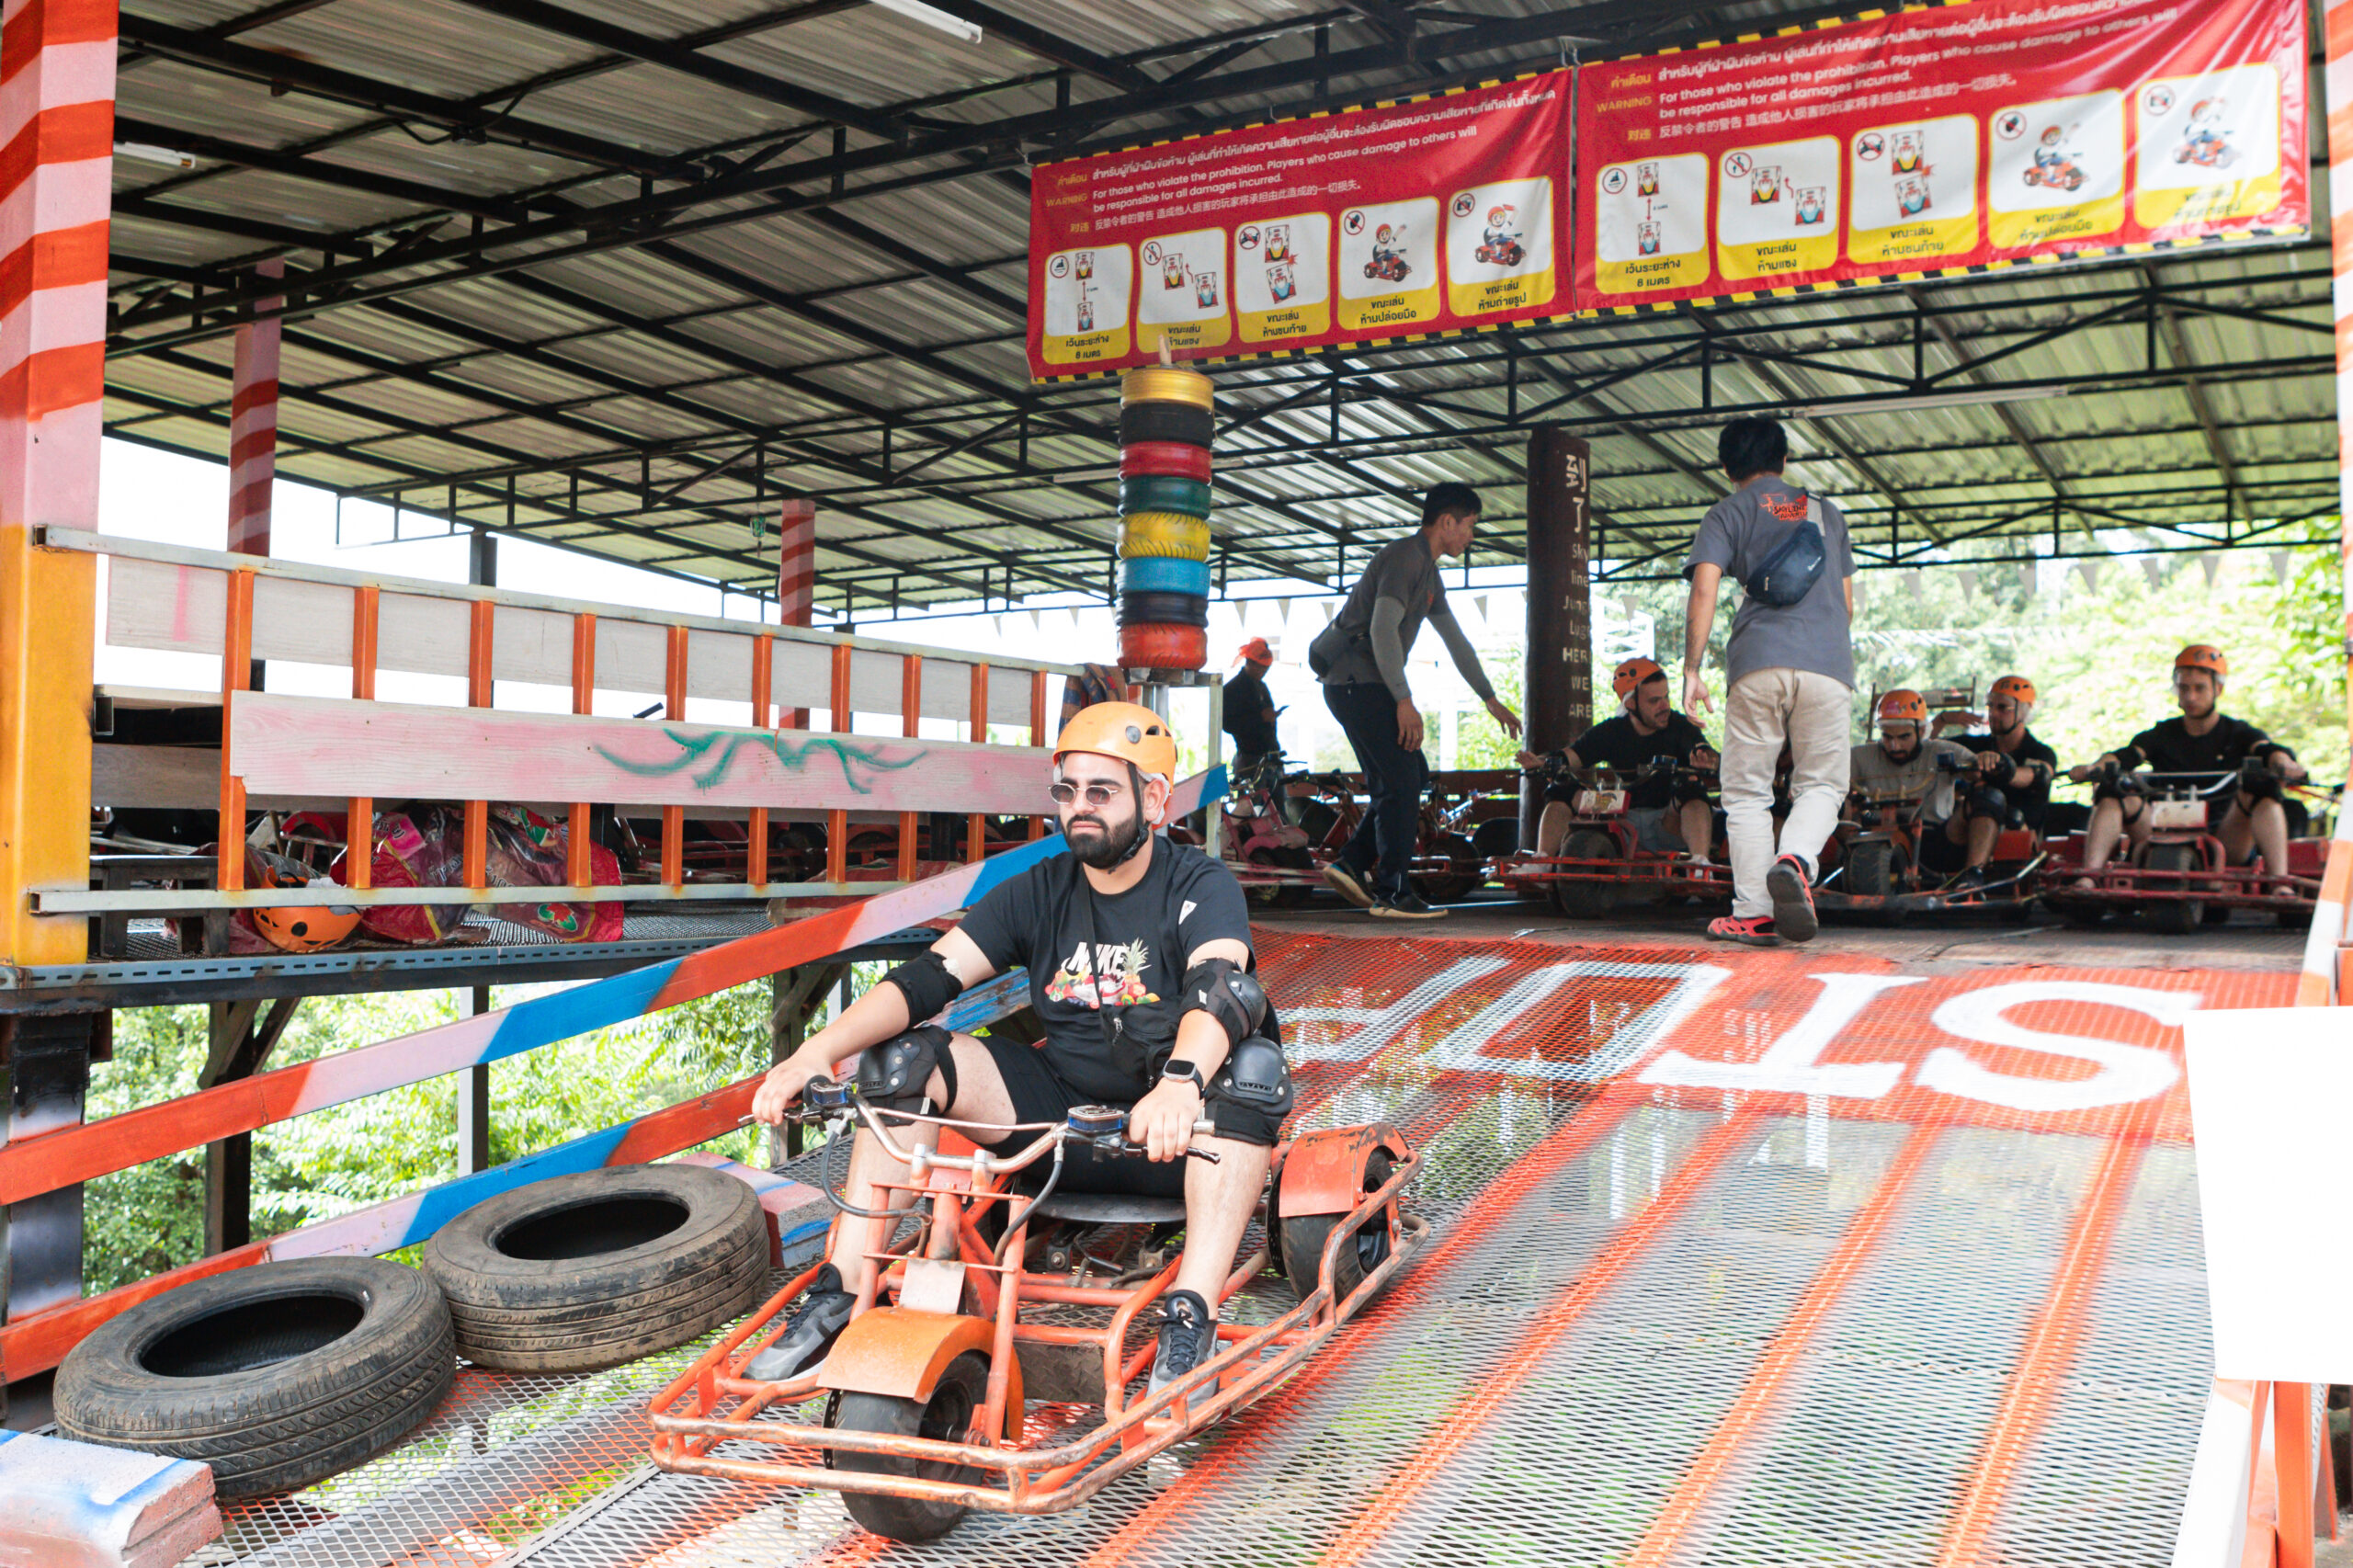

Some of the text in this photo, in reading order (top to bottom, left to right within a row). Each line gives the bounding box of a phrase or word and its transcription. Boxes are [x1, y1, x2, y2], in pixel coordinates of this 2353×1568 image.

[1660, 7, 2177, 105] For those who violate the prohibition. Players who cause damage to others will
[1610, 73, 1651, 89] คำเตือน
[1659, 69, 1913, 119] be responsible for all damages incurred.
[1597, 96, 1653, 113] WARNING
[1093, 125, 1478, 199] For those who violate the prohibition. Players who cause damage to others will
[1046, 194, 1087, 208] WARNING
[1093, 173, 1283, 213] be responsible for all damages incurred.
[1890, 224, 1934, 240] ขณะเล่น
[1756, 242, 1797, 256] ขณะเล่น
[1881, 241, 1944, 256] ห้ามชนท้าย
[1625, 257, 1681, 275] เว้นระยะห่าง
[1757, 258, 1797, 273] ห้ามแซง
[1484, 279, 1519, 295] ขณะเล่น
[1637, 277, 1670, 288] 8 เมตร
[1370, 296, 1404, 310] ขณะเล่น
[1478, 291, 1527, 311] ห้ามถ่ายรูป
[1267, 309, 1300, 323] ขณะเล่น
[1360, 307, 1417, 324] ห้ามปล่อยมือ
[1167, 323, 1201, 335] ขณะเล่น
[1263, 323, 1307, 337] ห้ามชนท้าย
[1065, 334, 1109, 348] เว้นระยะห่าง
[1083, 349, 1101, 358] เมตร
[1573, 543, 1588, 563] Sky
[1571, 569, 1588, 587] line
[1563, 595, 1589, 616] Jung
[1563, 647, 1591, 663] HER
[1571, 676, 1589, 691] WE
[1568, 703, 1592, 719] ARE
[1278, 956, 2206, 1113] STOP
